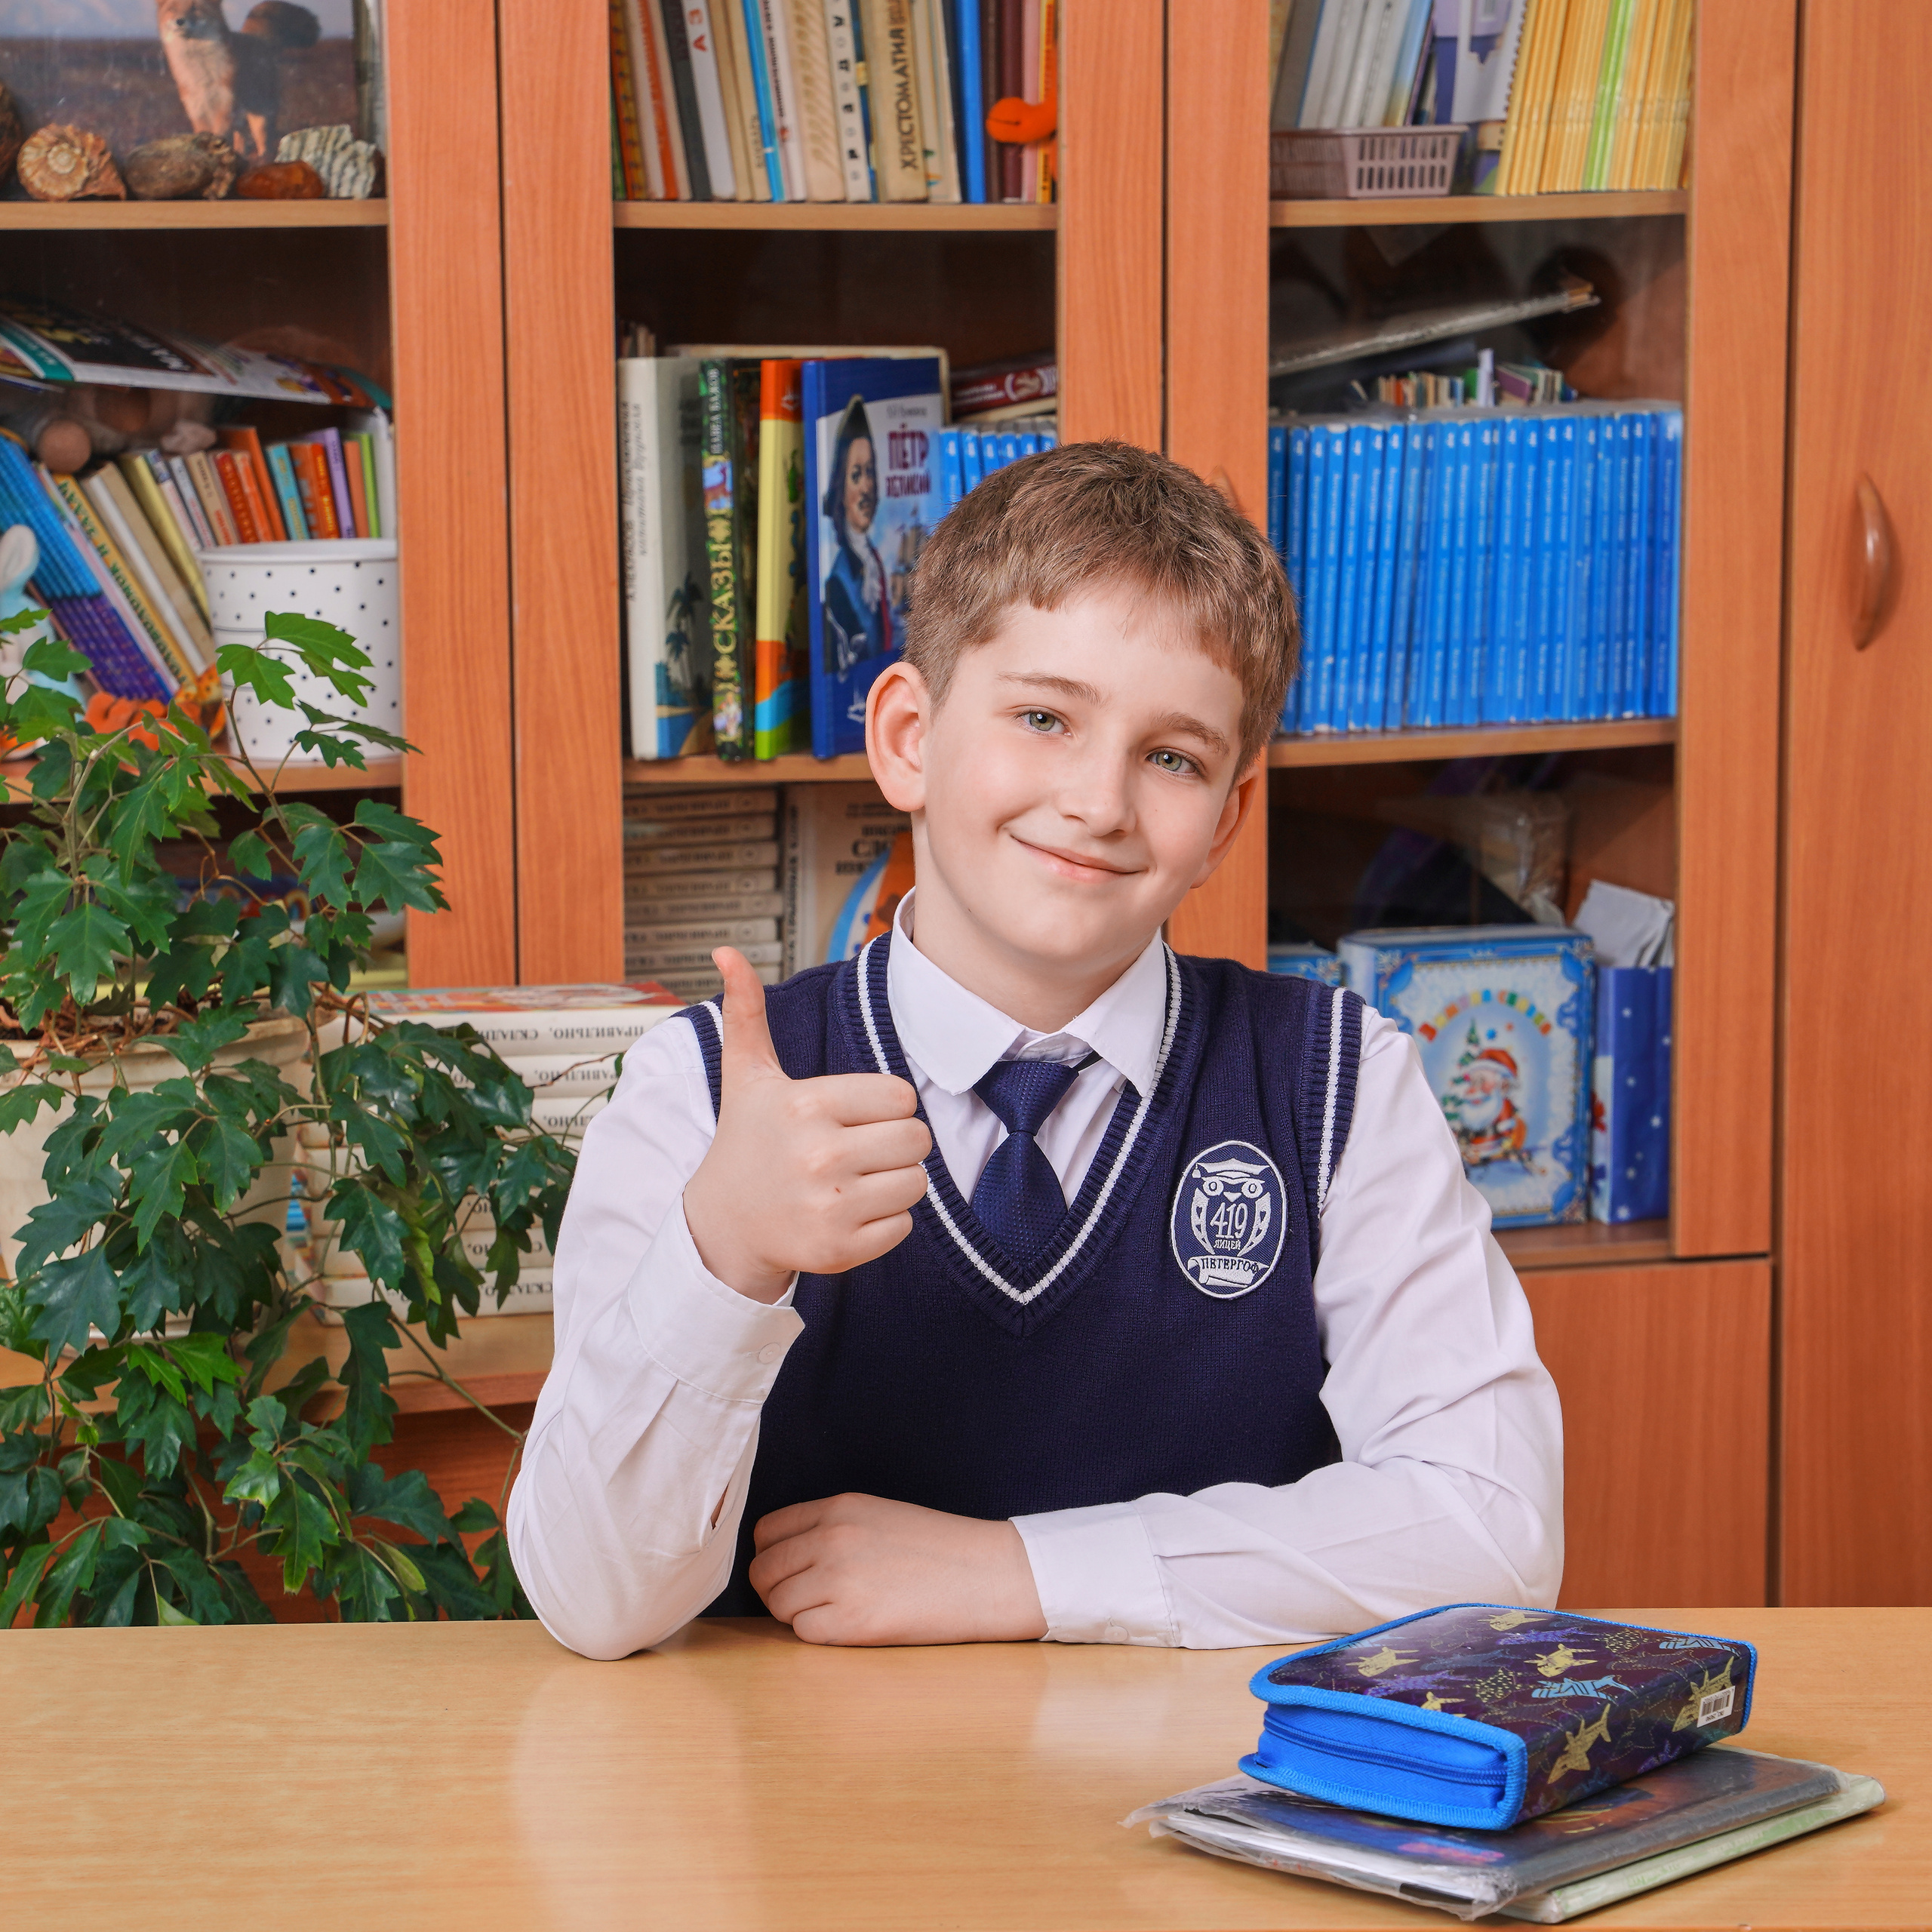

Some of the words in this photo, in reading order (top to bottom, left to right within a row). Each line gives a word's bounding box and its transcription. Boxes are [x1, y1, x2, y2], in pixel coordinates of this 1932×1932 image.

[889, 27, 918, 171] ХРЕСТОМАТИЯ
[887, 422, 930, 470] ПЁТР
[885, 470, 931, 498] ВЕЛИКИЙ
[709, 543, 737, 654] СКАЗЫ
[479, 1029, 539, 1041] СКЛАДН
[549, 1026, 644, 1039] ПРАВИЛЬНО,
[1210, 1201, 1248, 1239] 419
[1214, 1238, 1241, 1251] ЛИЦЕЙ
[1200, 1257, 1260, 1274] ПЕТЕРГОФ
